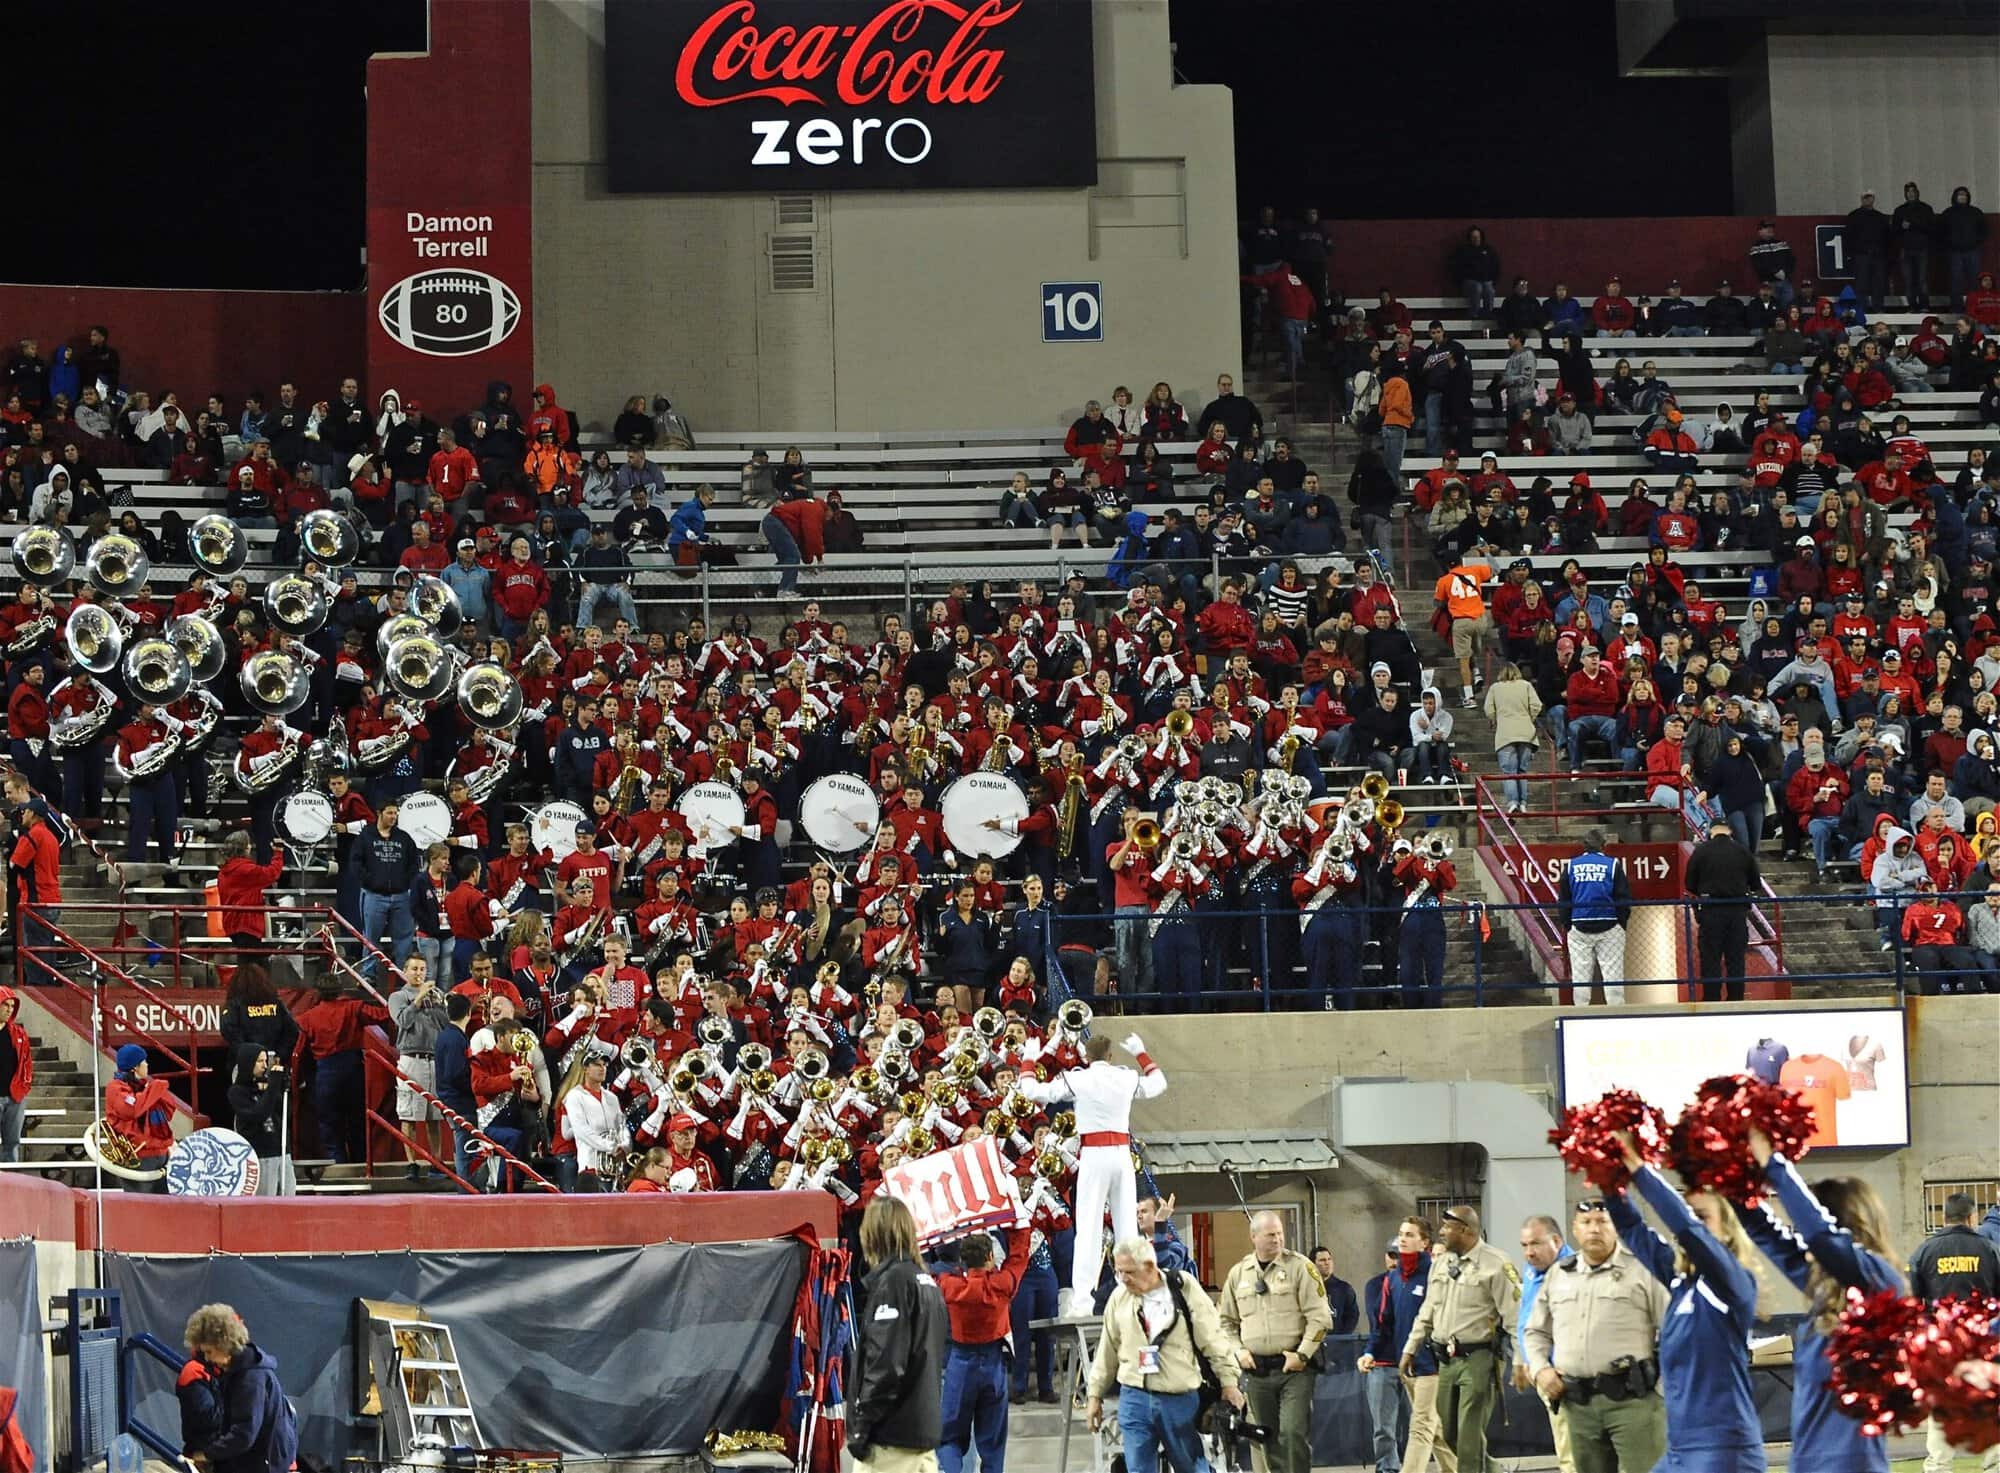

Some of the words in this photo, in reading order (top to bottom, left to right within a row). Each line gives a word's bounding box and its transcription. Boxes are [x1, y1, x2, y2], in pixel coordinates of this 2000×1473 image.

[675, 0, 1023, 107] Coca-Cola
[751, 117, 932, 165] zero
[407, 212, 492, 233] Damon
[412, 237, 488, 257] Terrell
[1825, 235, 1843, 269] 1
[436, 304, 467, 324] 80
[1045, 292, 1099, 331] 10
[442, 464, 449, 483] 1
[1451, 574, 1478, 599] 42
[837, 782, 865, 796] YAMAHA
[978, 779, 1007, 791] YAMAHA
[414, 799, 438, 808] YAMAHA
[703, 790, 732, 800] YAMAHA
[552, 812, 582, 822] YAMAHA
[1572, 864, 1608, 874] EVENT
[1575, 872, 1606, 882] STAFF
[1633, 856, 1649, 879] 11
[1932, 913, 1946, 928] 7
[136, 1004, 220, 1032] SECTION
[247, 1004, 277, 1017] SECURITY
[242, 1158, 258, 1196] ARIZO
[1937, 1256, 1980, 1274] SECURITY
